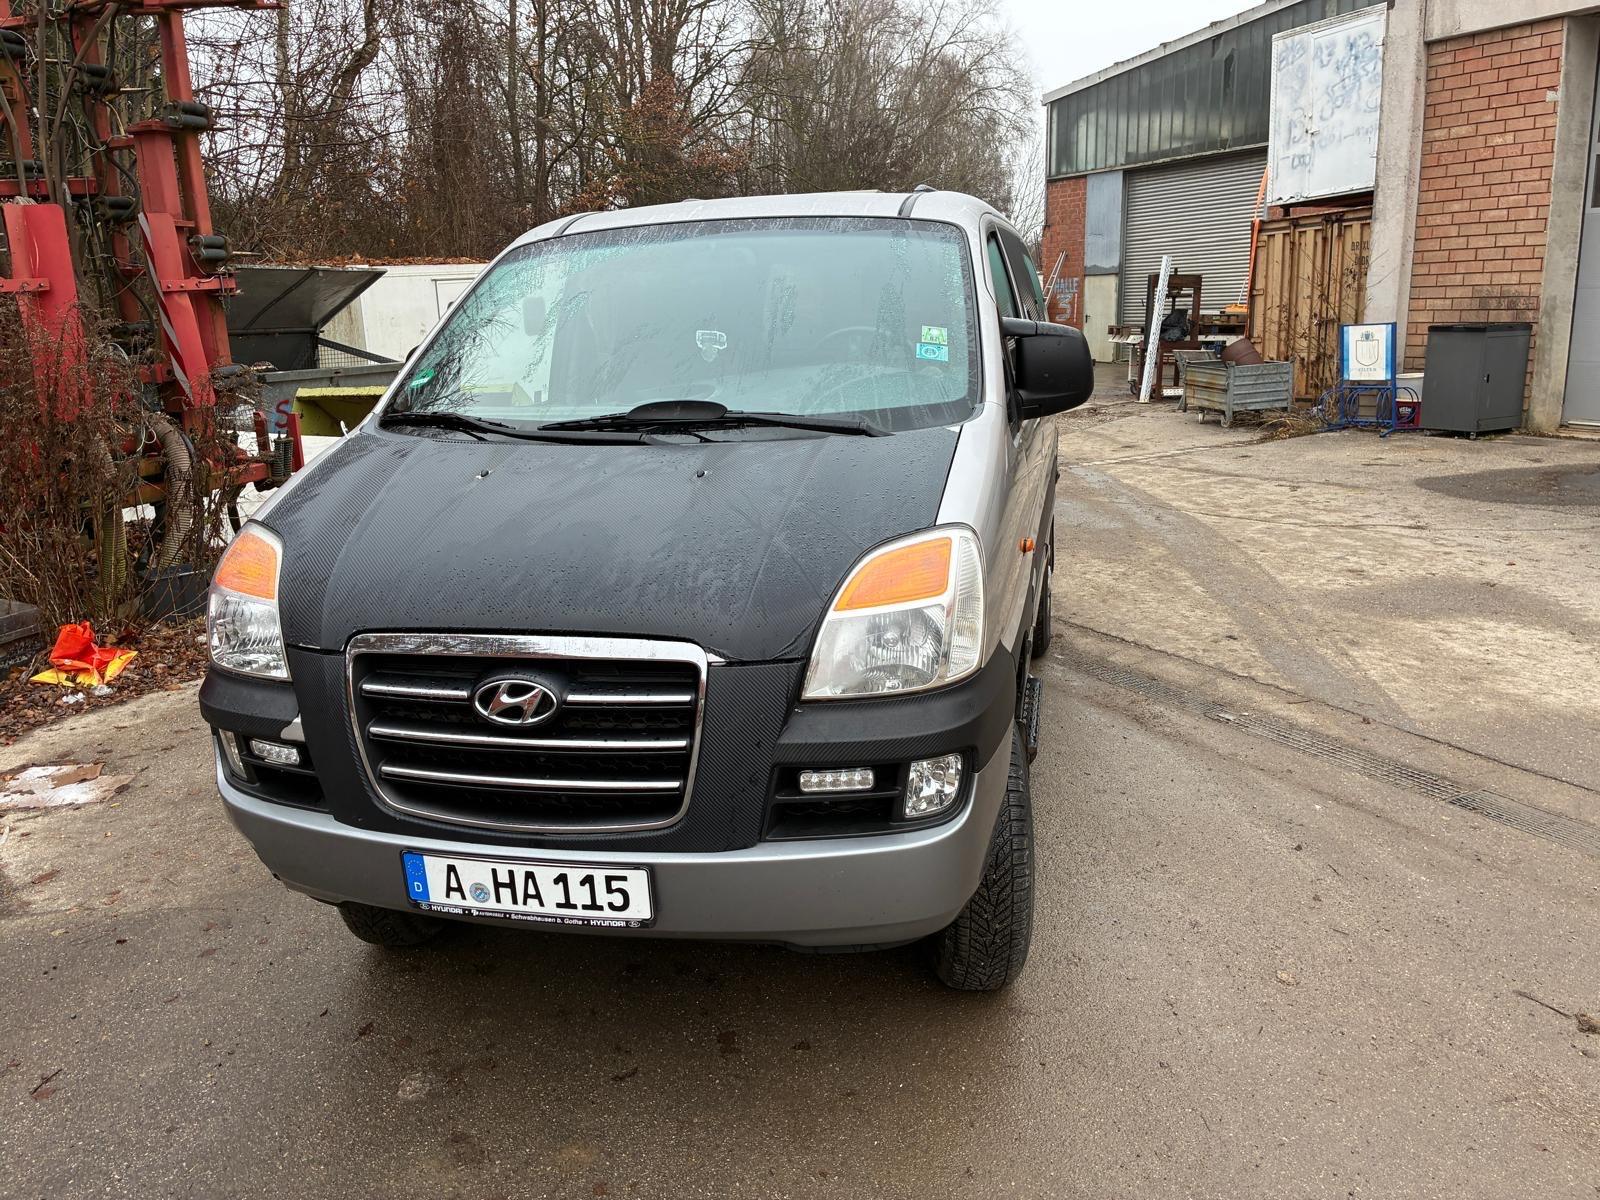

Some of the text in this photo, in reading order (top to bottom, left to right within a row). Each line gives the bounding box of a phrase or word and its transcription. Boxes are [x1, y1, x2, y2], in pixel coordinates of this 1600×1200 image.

[1054, 277, 1079, 293] HALLE
[414, 882, 423, 892] D
[446, 863, 630, 912] A HA 115
[431, 904, 463, 915] HYUNDAI
[510, 913, 556, 923] Schwabhausen
[590, 919, 627, 927] HYUNDAI
